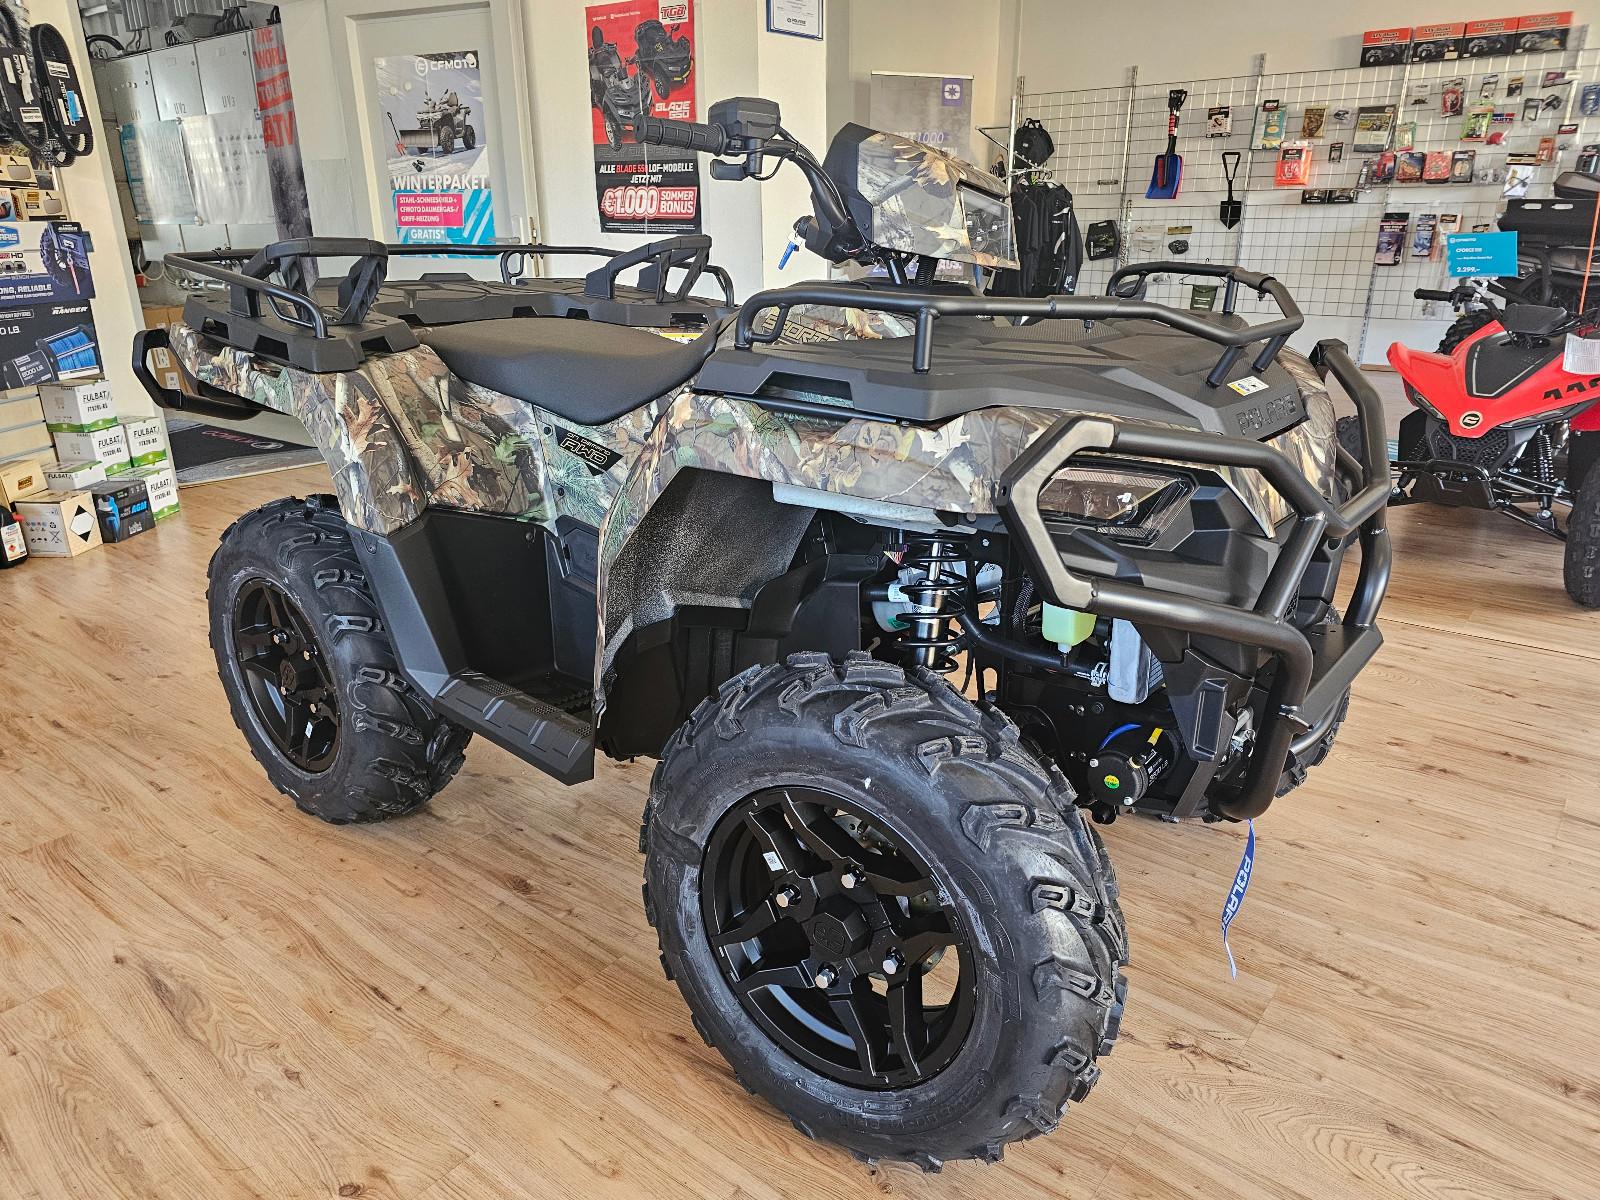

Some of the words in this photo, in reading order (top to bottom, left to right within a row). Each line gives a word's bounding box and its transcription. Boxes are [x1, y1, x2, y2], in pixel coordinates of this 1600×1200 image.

[661, 5, 686, 19] TGB
[655, 101, 691, 112] BLADE
[263, 111, 294, 148] ATV
[600, 165, 615, 174] ALLE
[616, 164, 637, 173] BLADE
[649, 163, 694, 172] LOF-MODELLE
[392, 174, 488, 190] WINTERPAKET
[630, 175, 650, 183] JETZT
[604, 189, 658, 215] €1.000
[661, 191, 694, 201] SOMMER
[660, 202, 694, 213] BONUS
[11, 252, 24, 262] HD
[17, 284, 52, 293] RELIABLE
[52, 306, 88, 315] RANGER
[8, 325, 20, 334] LB
[82, 390, 107, 402] FULBAT
[133, 426, 157, 438] FULBAT
[98, 435, 120, 448] FULBAT
[560, 437, 608, 465] AWD
[150, 479, 170, 492] FULBAT
[131, 501, 147, 513] AGM
[1222, 855, 1251, 931] POLAR
